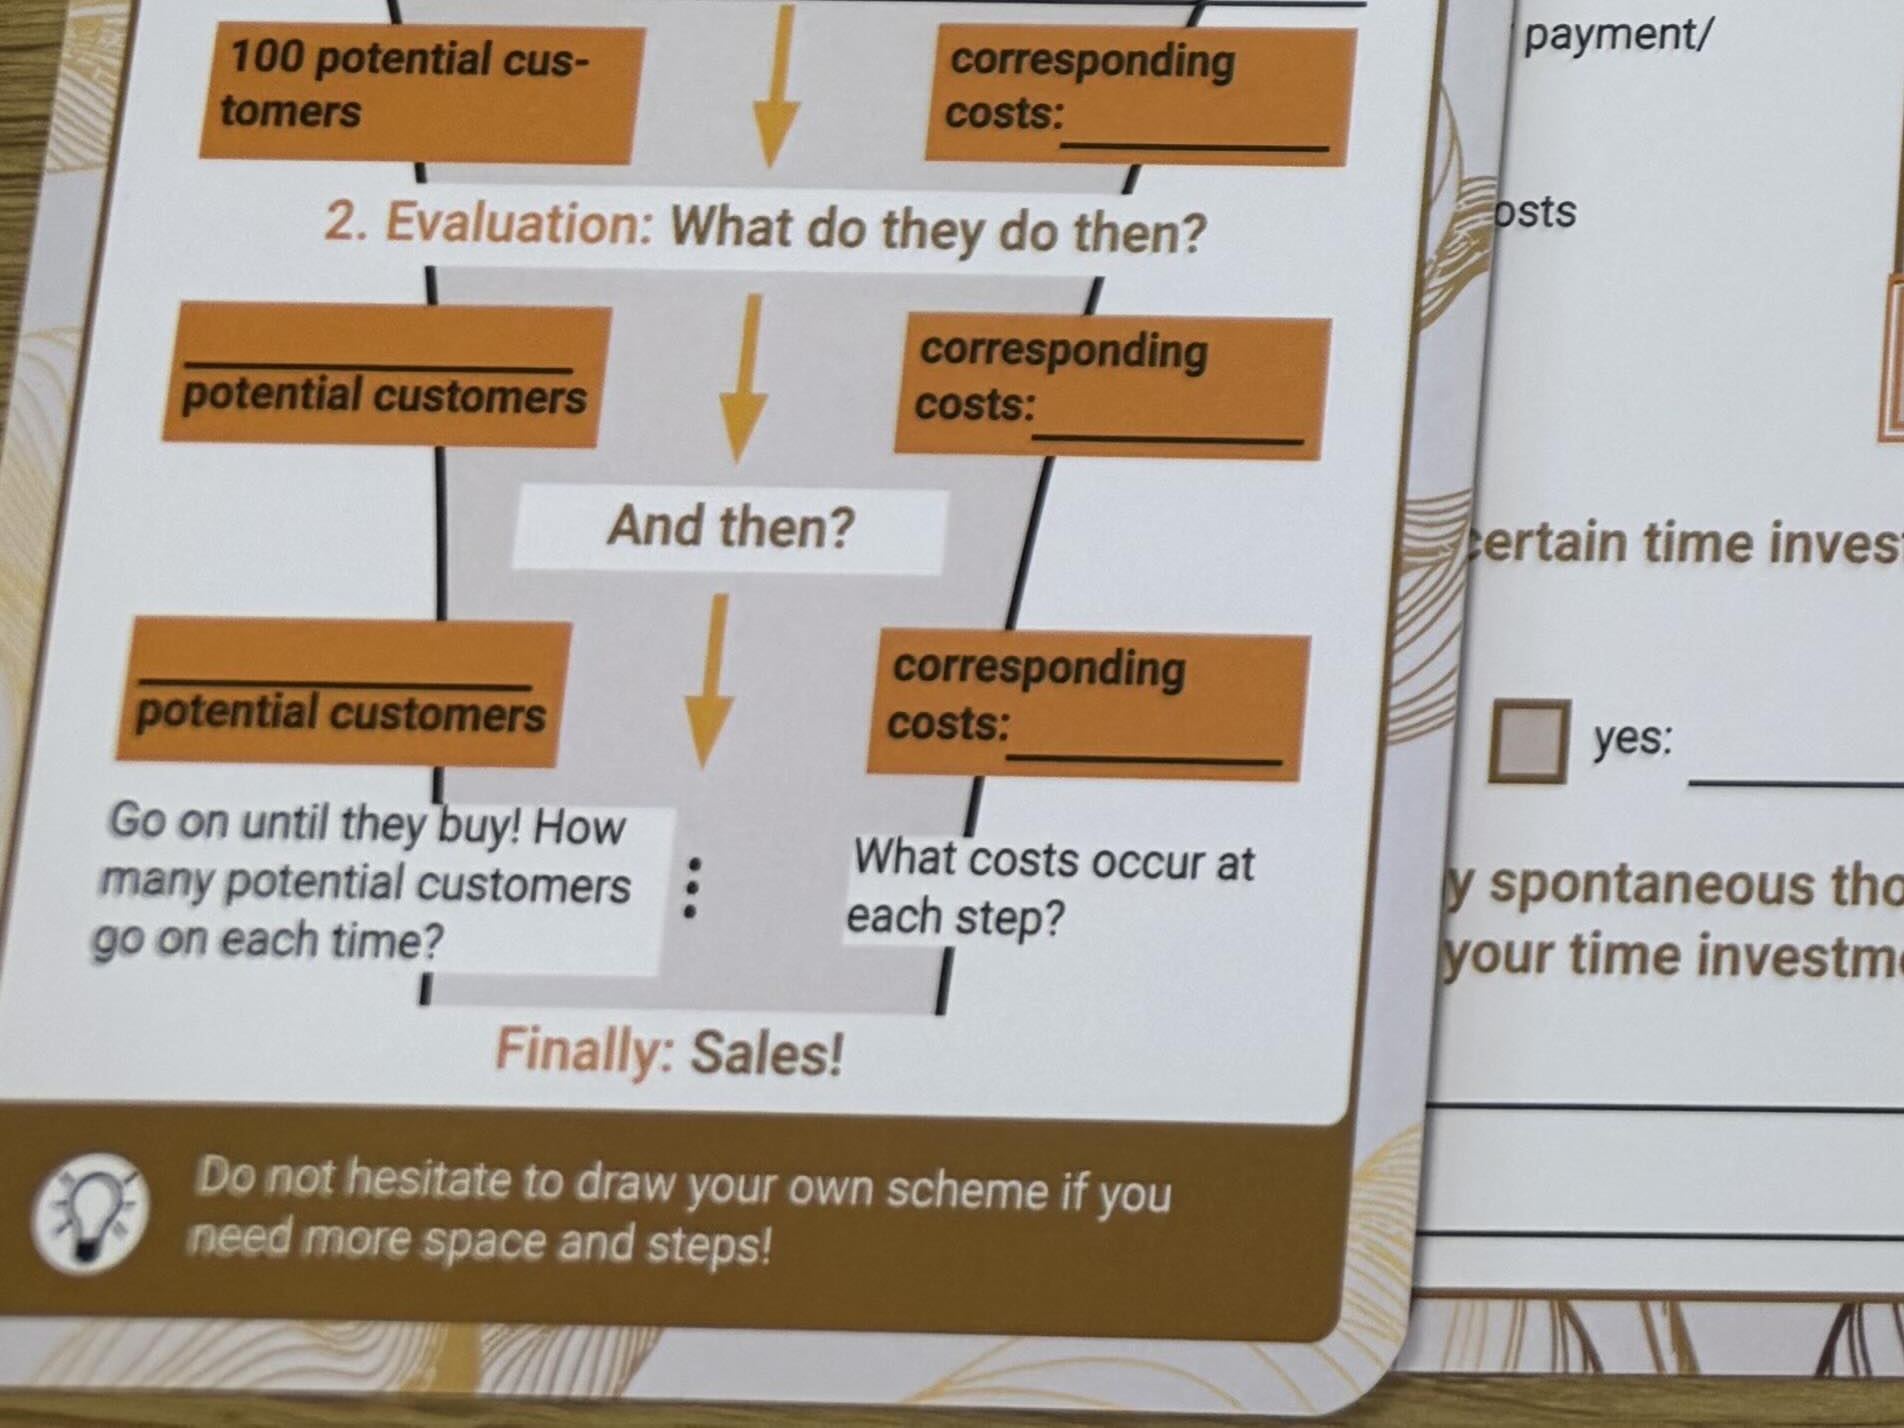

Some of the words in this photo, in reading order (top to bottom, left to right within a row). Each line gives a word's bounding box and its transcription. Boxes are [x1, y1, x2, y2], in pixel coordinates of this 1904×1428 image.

[232, 37, 305, 73] 100
[314, 39, 493, 82] potential
[503, 49, 590, 78] cus-
[1524, 15, 1716, 60] payment/
[950, 40, 1236, 87] corresponding
[220, 94, 362, 129] tomers
[606, 501, 705, 547] And
[719, 502, 856, 549] then?
[1593, 726, 1674, 765] yes:
[495, 1024, 675, 1086] Finally:
[690, 1028, 844, 1077] Sales!
[187, 1213, 294, 1258] need
[302, 1225, 412, 1257] more
[420, 1227, 547, 1268] space
[557, 1221, 636, 1263] and
[647, 1226, 773, 1273] steps!
